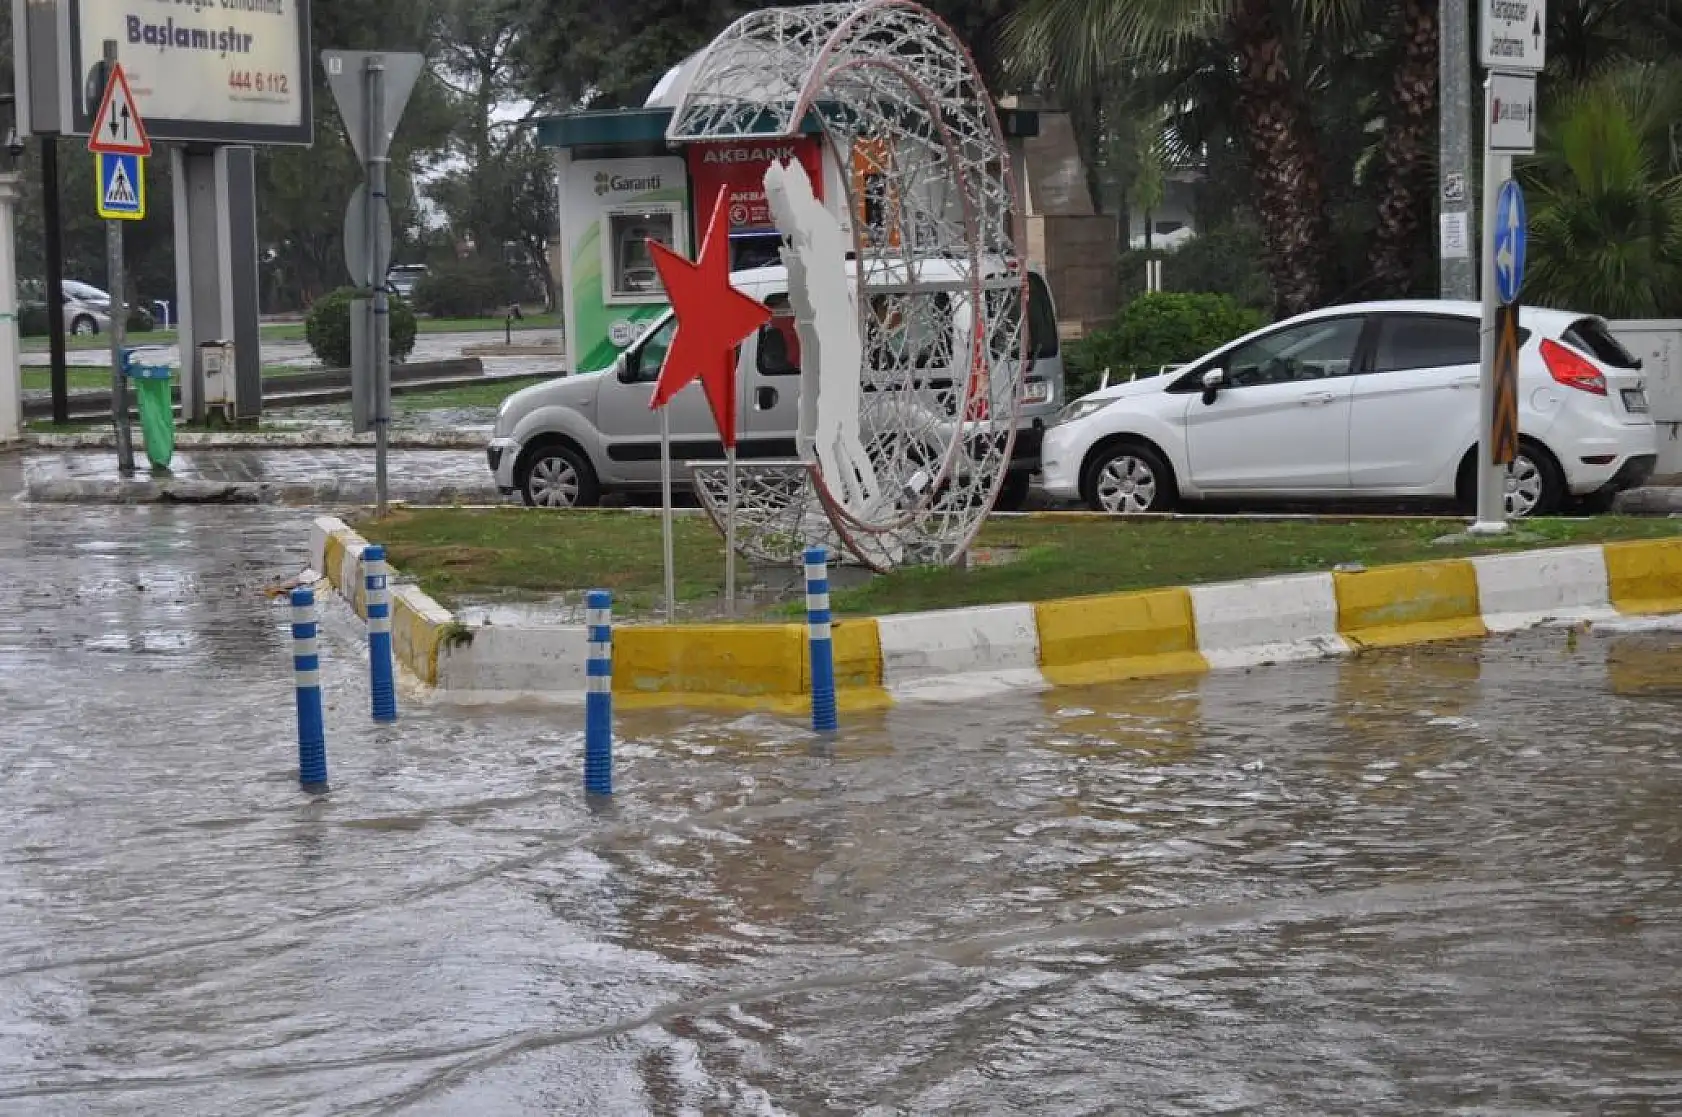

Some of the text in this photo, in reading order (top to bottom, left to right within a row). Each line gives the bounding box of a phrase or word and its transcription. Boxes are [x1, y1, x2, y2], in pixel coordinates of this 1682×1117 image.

[126, 15, 253, 58] Başlamıştır
[228, 70, 251, 90] 444
[703, 147, 795, 164] AKBANK
[611, 175, 661, 191] Garanti
[730, 192, 767, 201] AKBA
